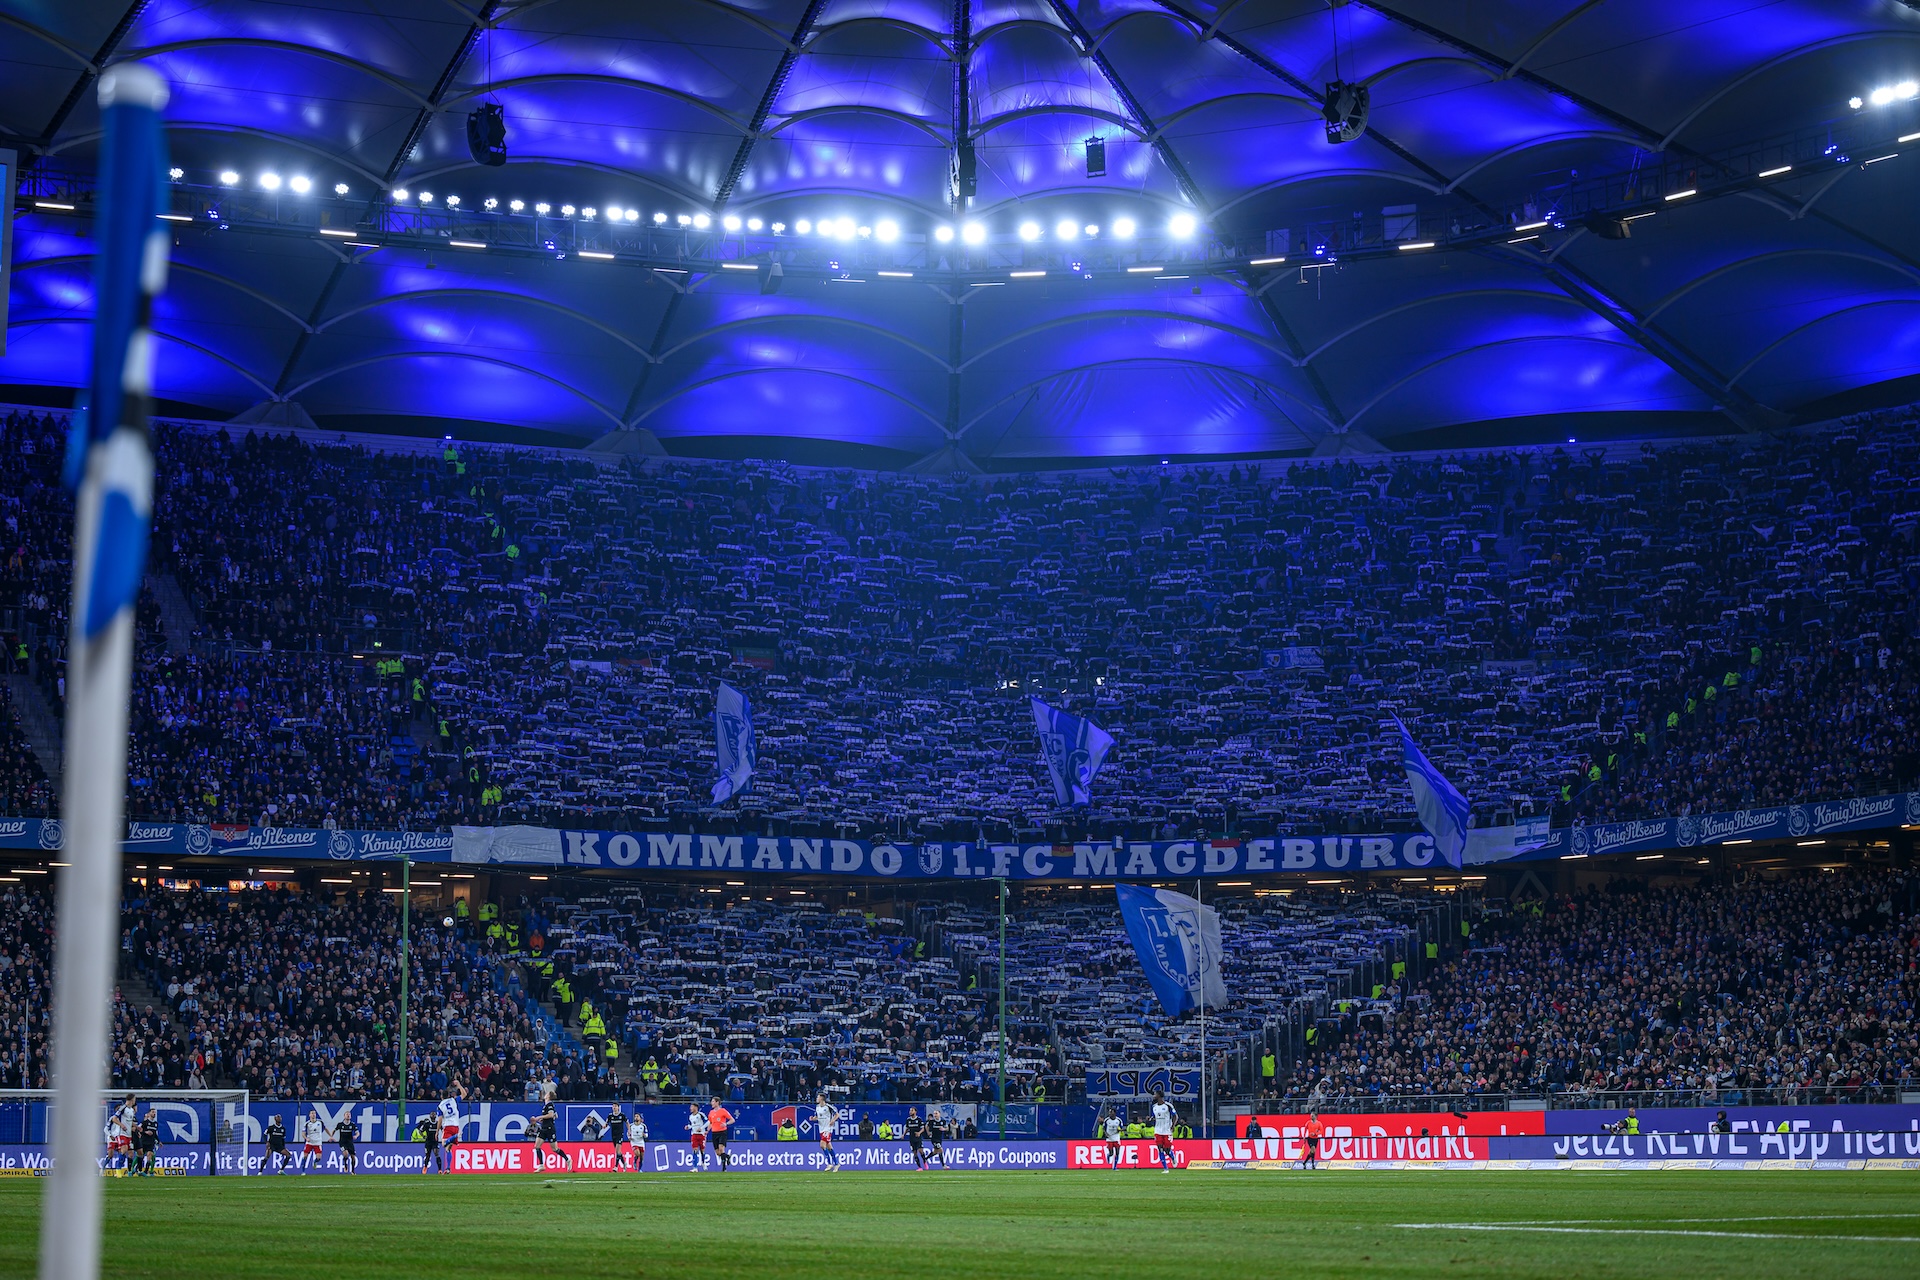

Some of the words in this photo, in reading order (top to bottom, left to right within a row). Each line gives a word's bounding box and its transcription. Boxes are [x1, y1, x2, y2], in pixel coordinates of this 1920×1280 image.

[566, 831, 902, 875] KOMMANDO
[1073, 835, 1435, 876] MAGDEBURG
[446, 1103, 454, 1115] 5
[986, 1114, 1027, 1124] DESAU
[455, 1149, 521, 1170] REWE
[767, 1150, 804, 1166] extra
[865, 1148, 889, 1165] Mit
[968, 1148, 995, 1168] App
[999, 1146, 1056, 1168] Coupons
[1075, 1145, 1139, 1165] REWE
